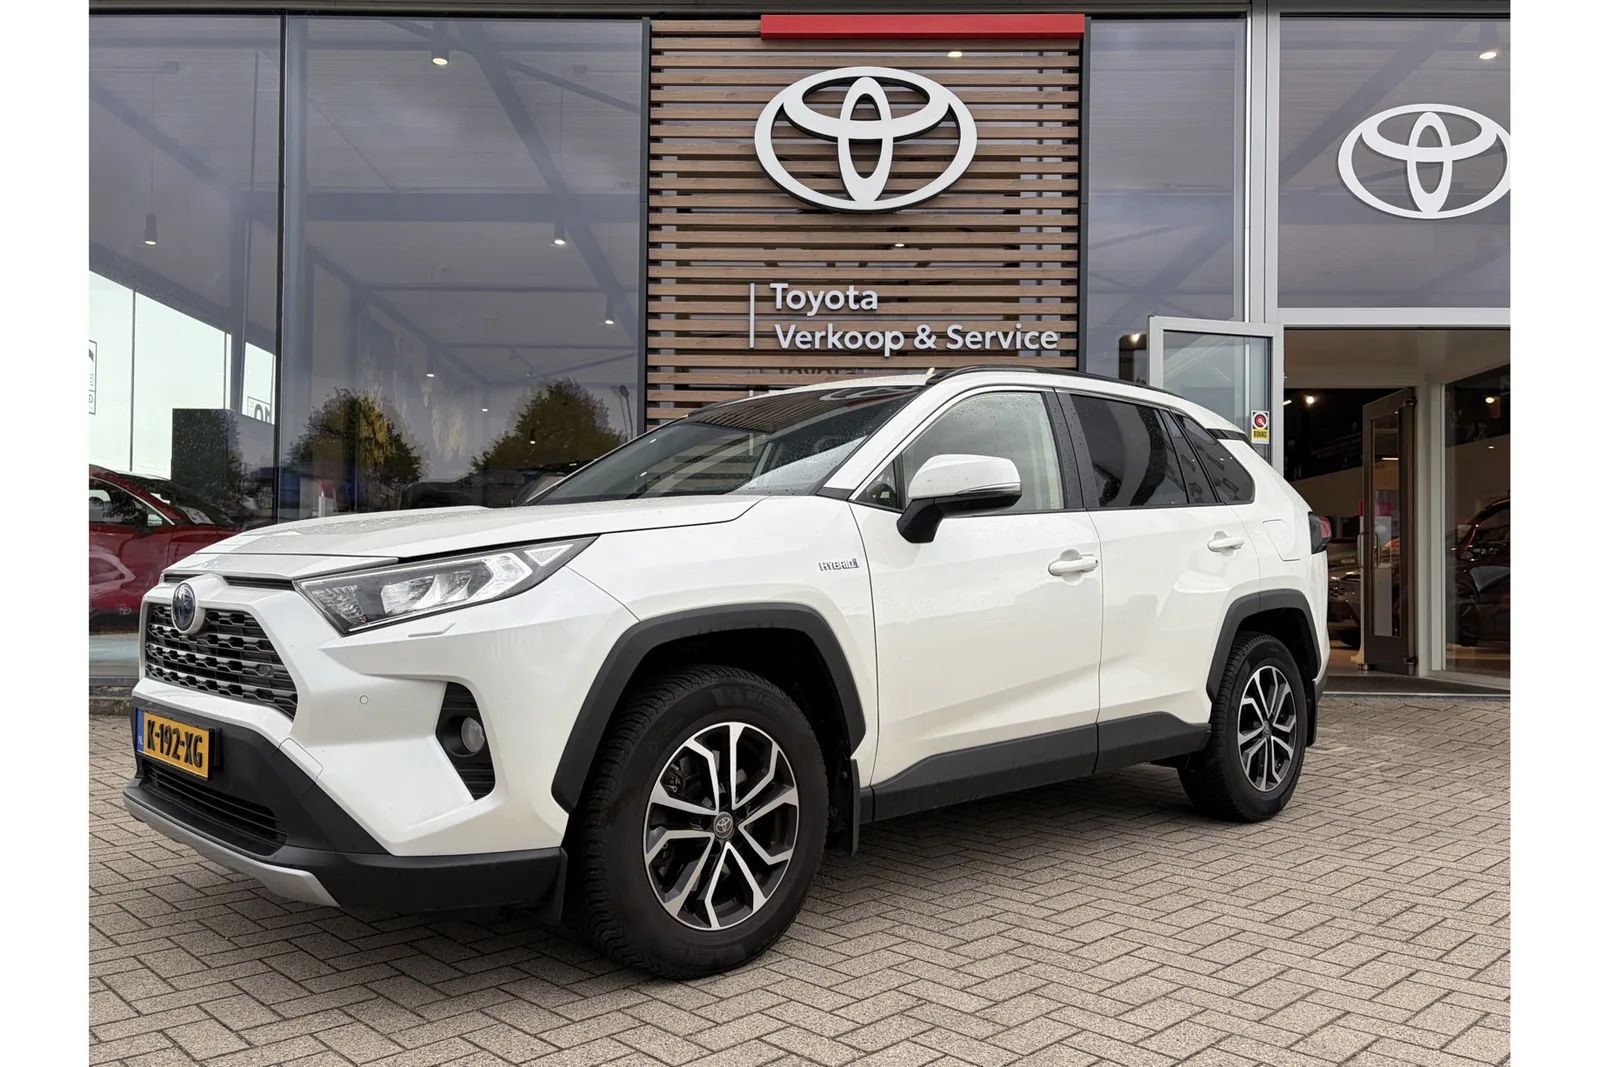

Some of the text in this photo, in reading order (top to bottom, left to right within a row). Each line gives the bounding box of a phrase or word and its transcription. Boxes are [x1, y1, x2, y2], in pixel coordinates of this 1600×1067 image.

[770, 283, 878, 317] Toyota
[774, 323, 1059, 357] Verkoop & Service
[818, 560, 853, 571] HYBRID
[147, 719, 203, 769] K-192-XG
